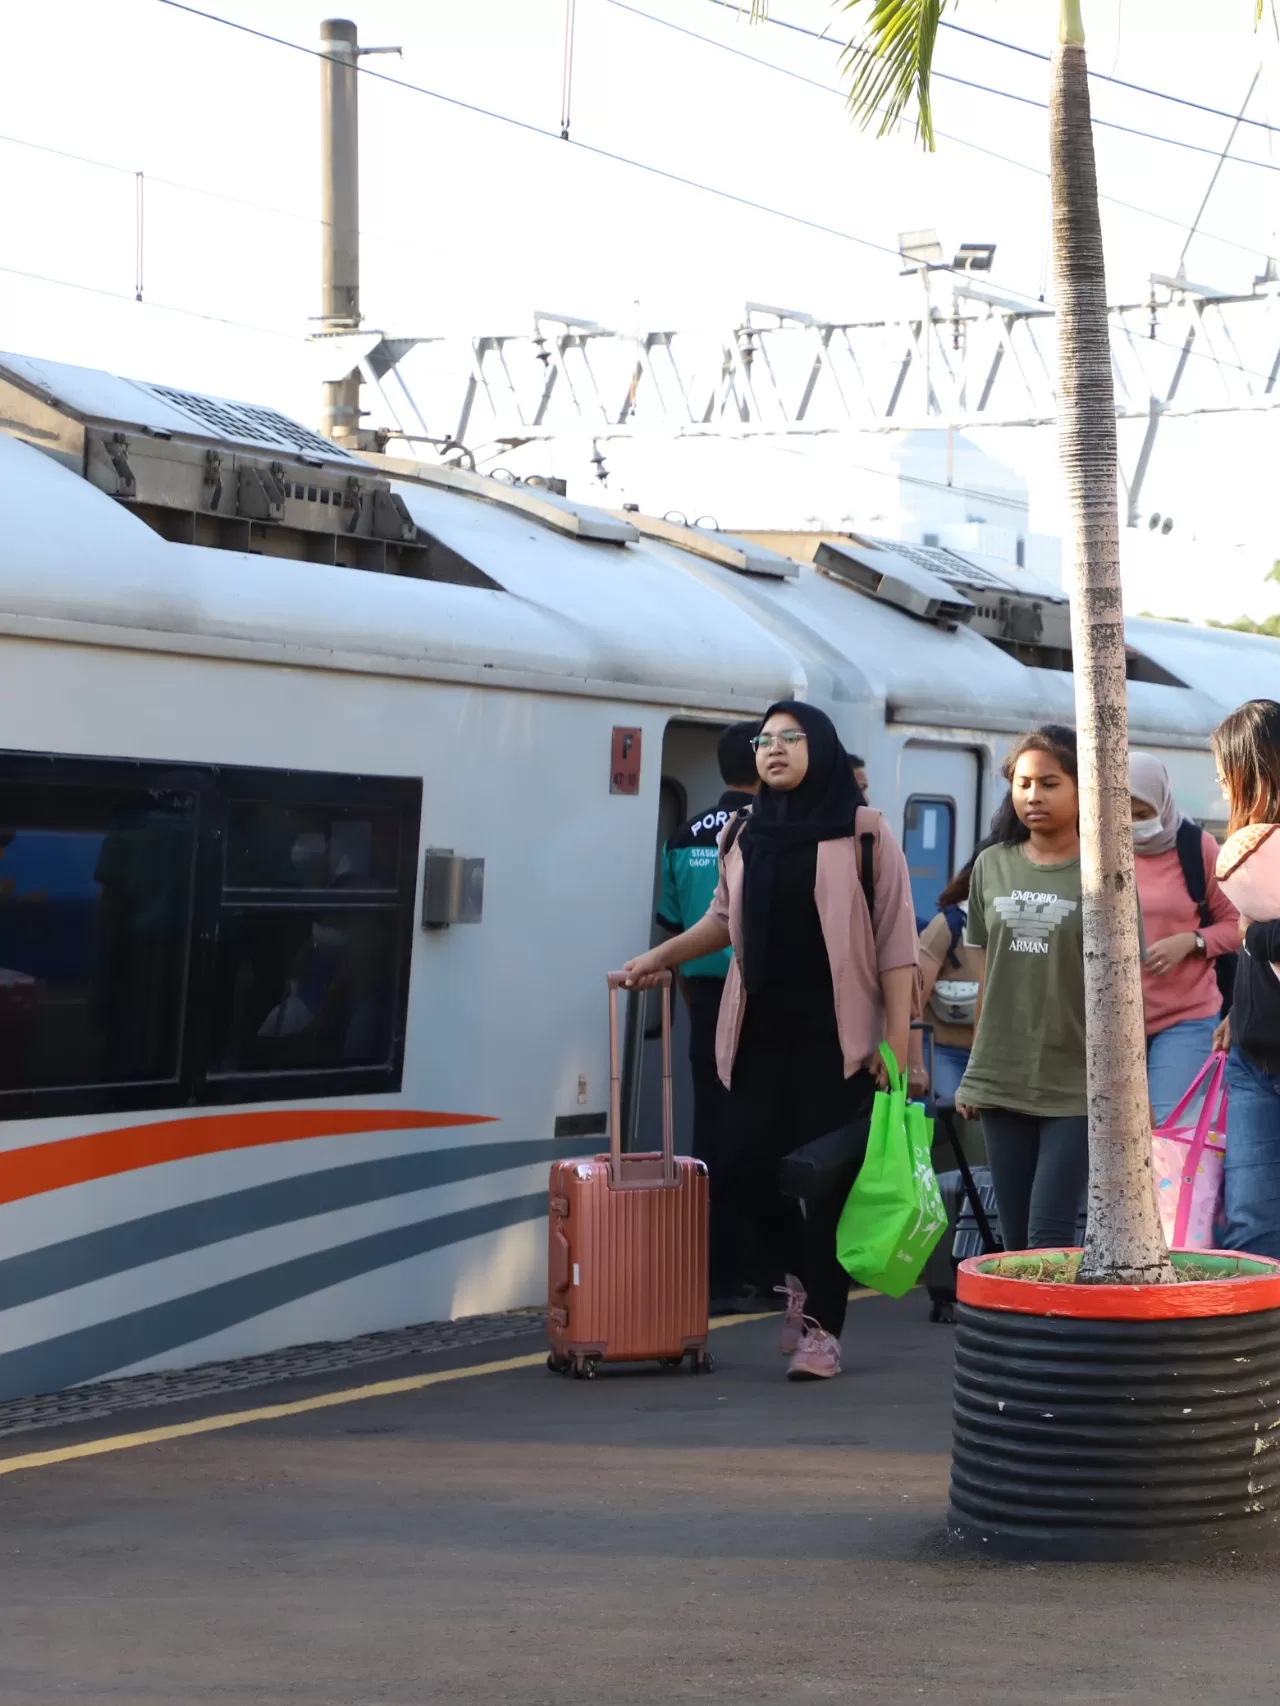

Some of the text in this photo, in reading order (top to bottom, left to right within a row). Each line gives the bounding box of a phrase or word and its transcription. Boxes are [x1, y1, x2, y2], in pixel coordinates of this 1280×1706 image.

[622, 733, 633, 760] F
[691, 811, 729, 837] POR
[691, 849, 719, 858] STASIU
[1010, 889, 1058, 904] EMPORIO
[1008, 940, 1049, 954] ARMANI
